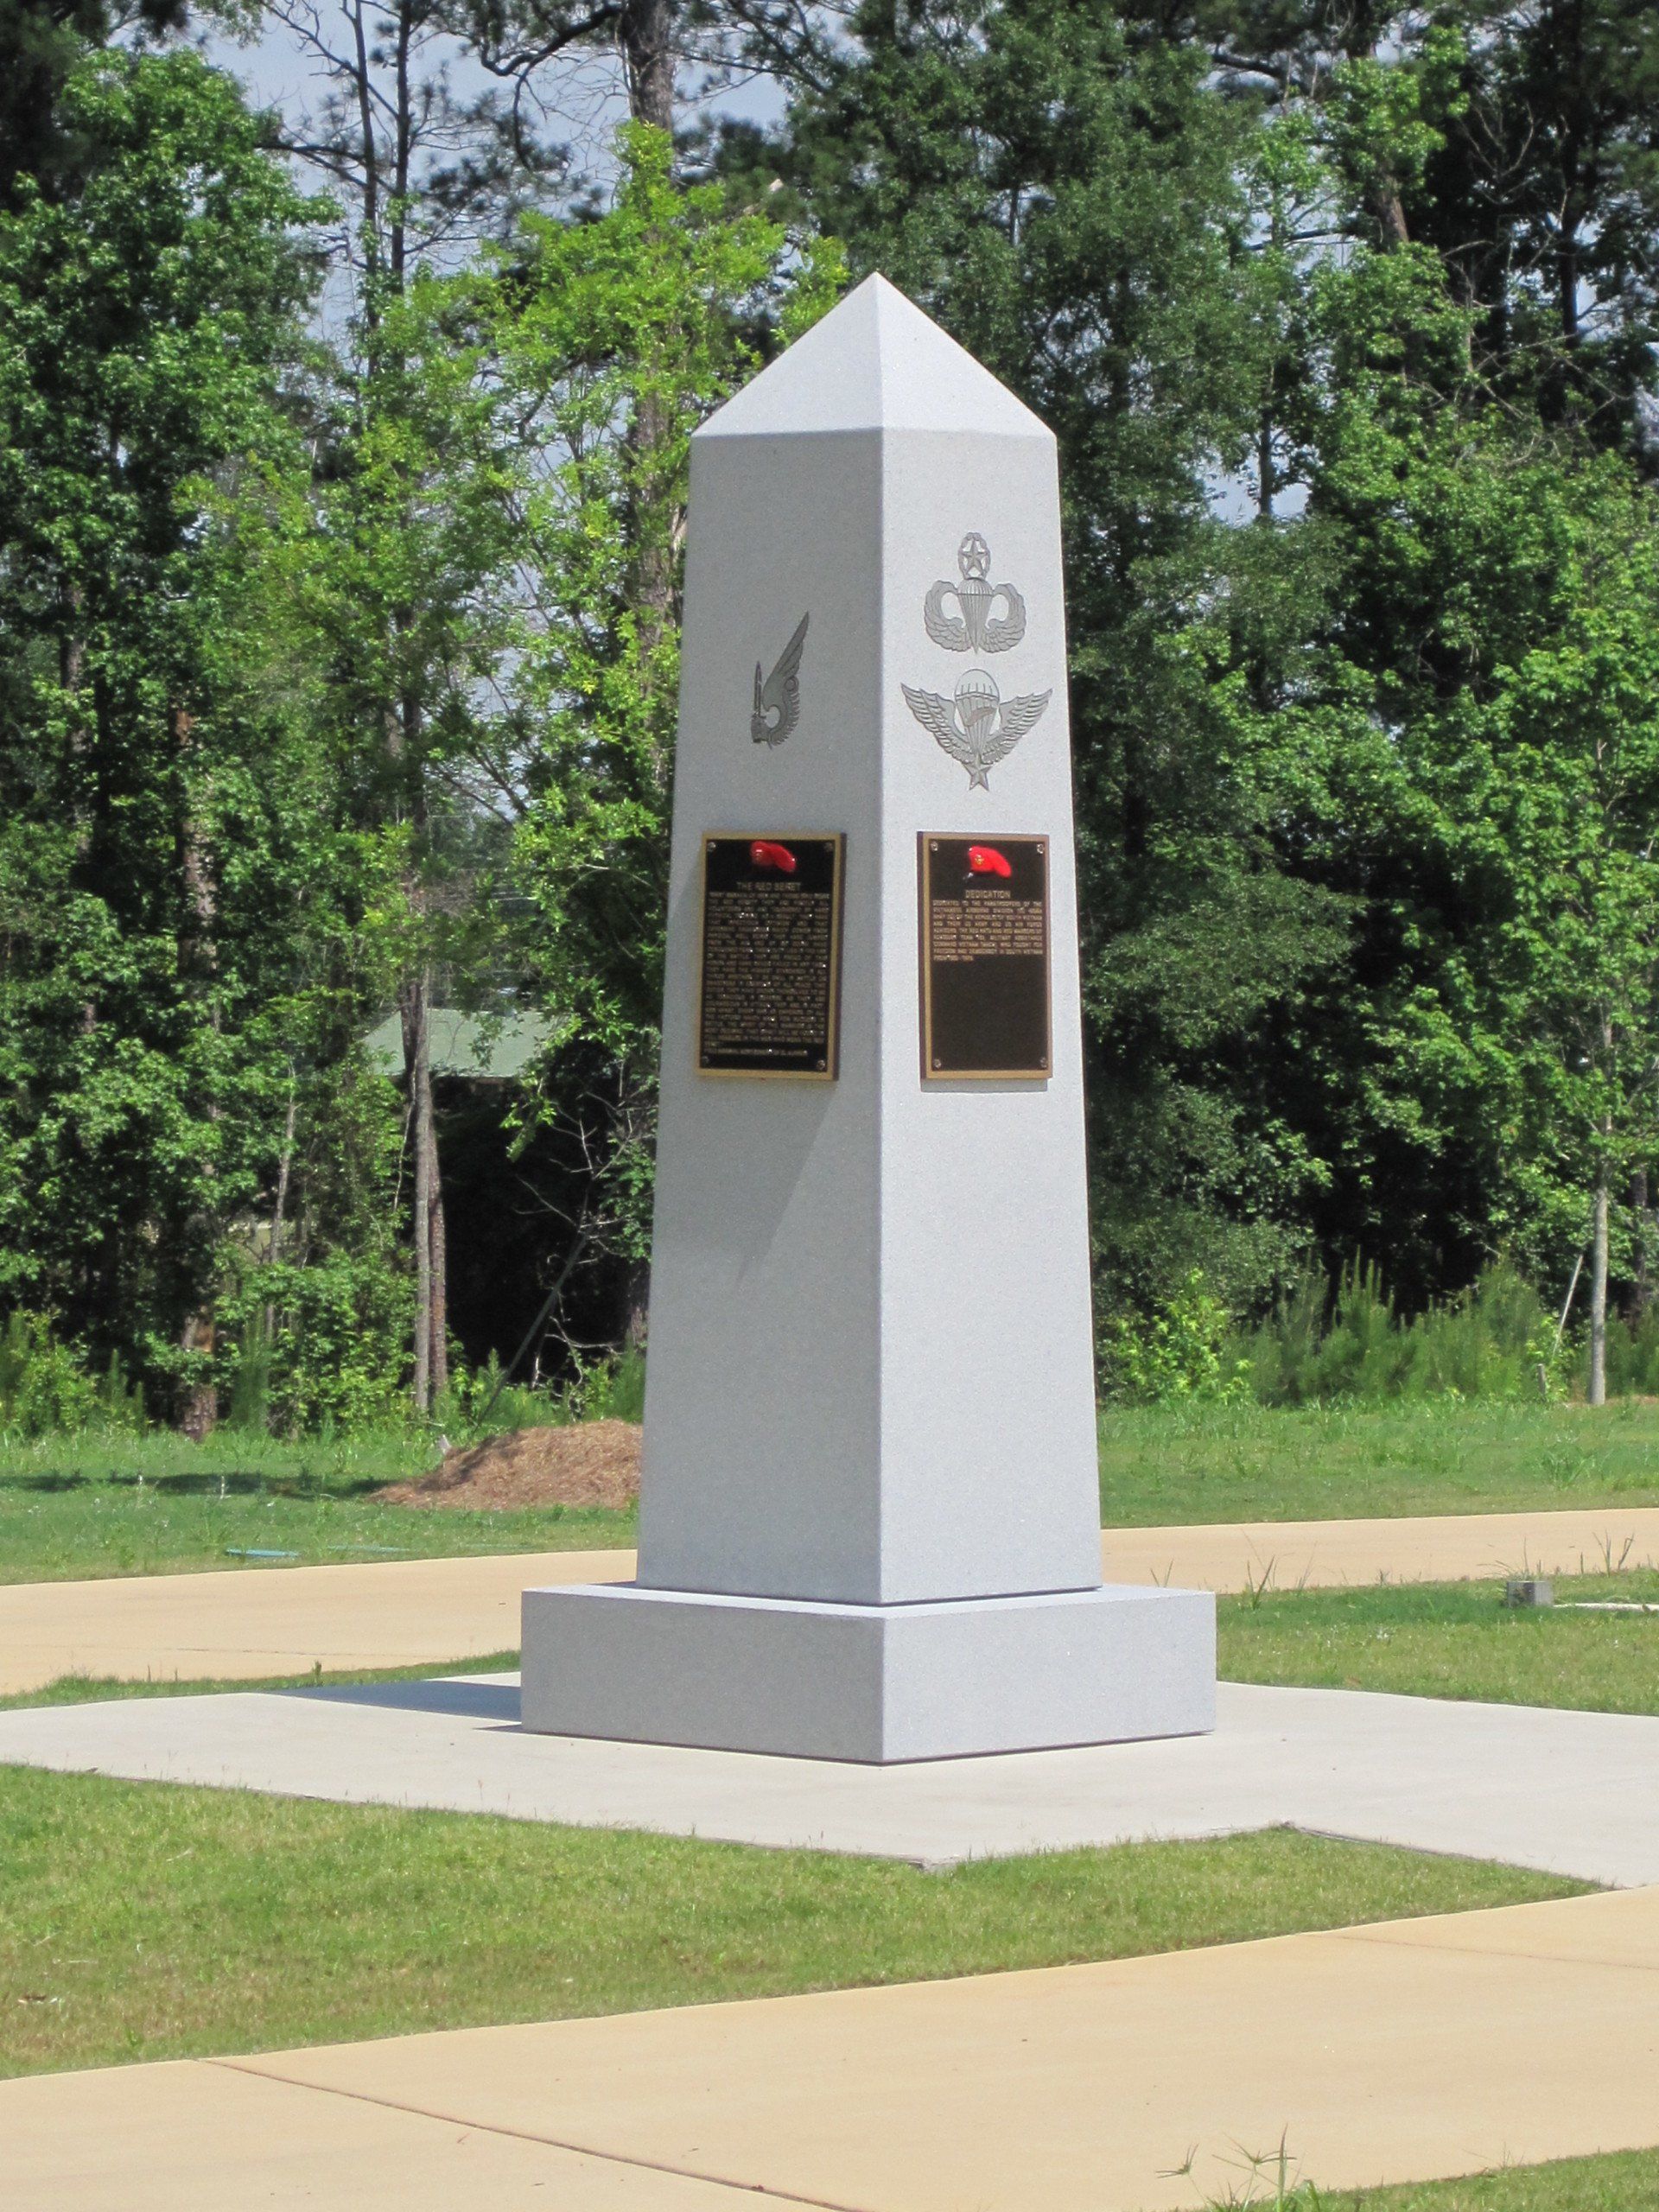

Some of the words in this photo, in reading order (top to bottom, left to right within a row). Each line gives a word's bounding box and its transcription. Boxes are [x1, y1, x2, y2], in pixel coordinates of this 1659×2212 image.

[736, 881, 752, 891] THE
[754, 881, 772, 891] RED
[774, 881, 801, 891] BERET
[965, 890, 1010, 899] DEDICATION
